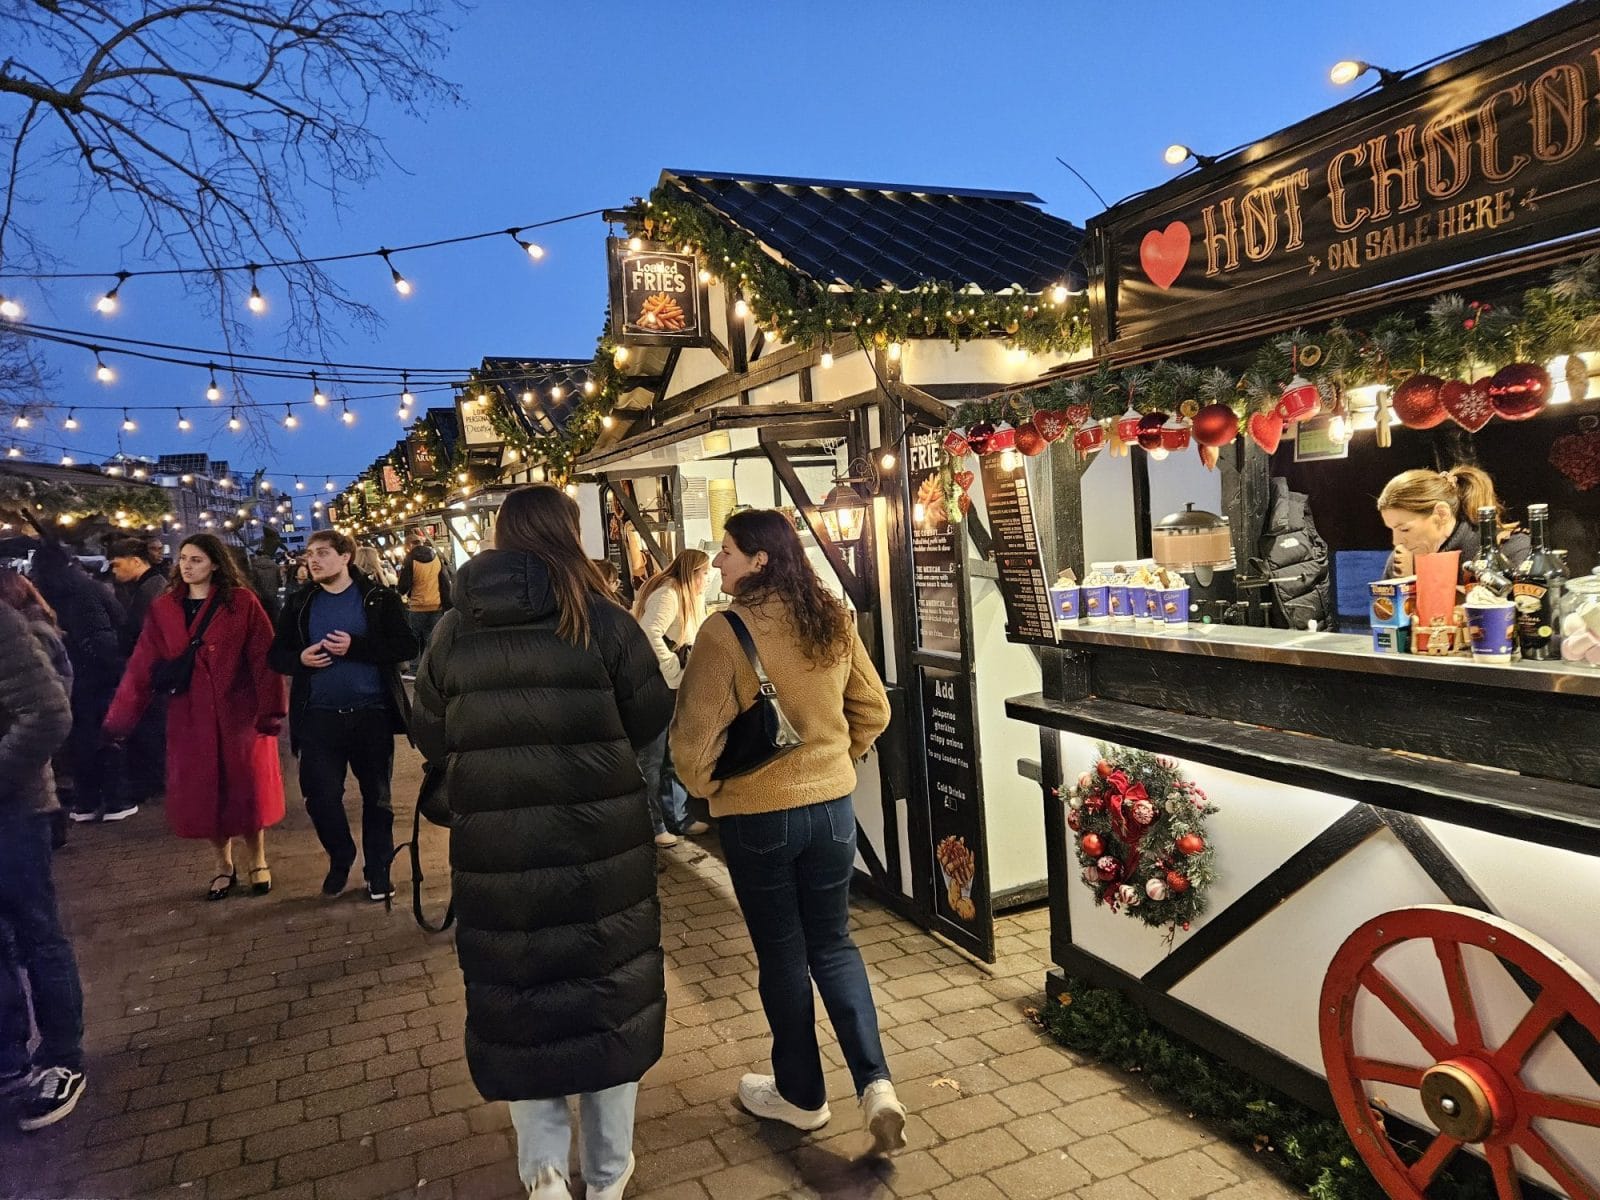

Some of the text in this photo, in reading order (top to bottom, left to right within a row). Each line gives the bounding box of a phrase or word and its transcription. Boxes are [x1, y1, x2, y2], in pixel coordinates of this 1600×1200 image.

[1201, 48, 1600, 278] HOT CHOCO
[1327, 186, 1516, 271] ON SALE HERE
[636, 260, 678, 275] Loaded
[632, 271, 686, 293] FRIES
[935, 680, 955, 700] Add
[934, 720, 956, 734] gherkins
[930, 733, 964, 750] crispy onions
